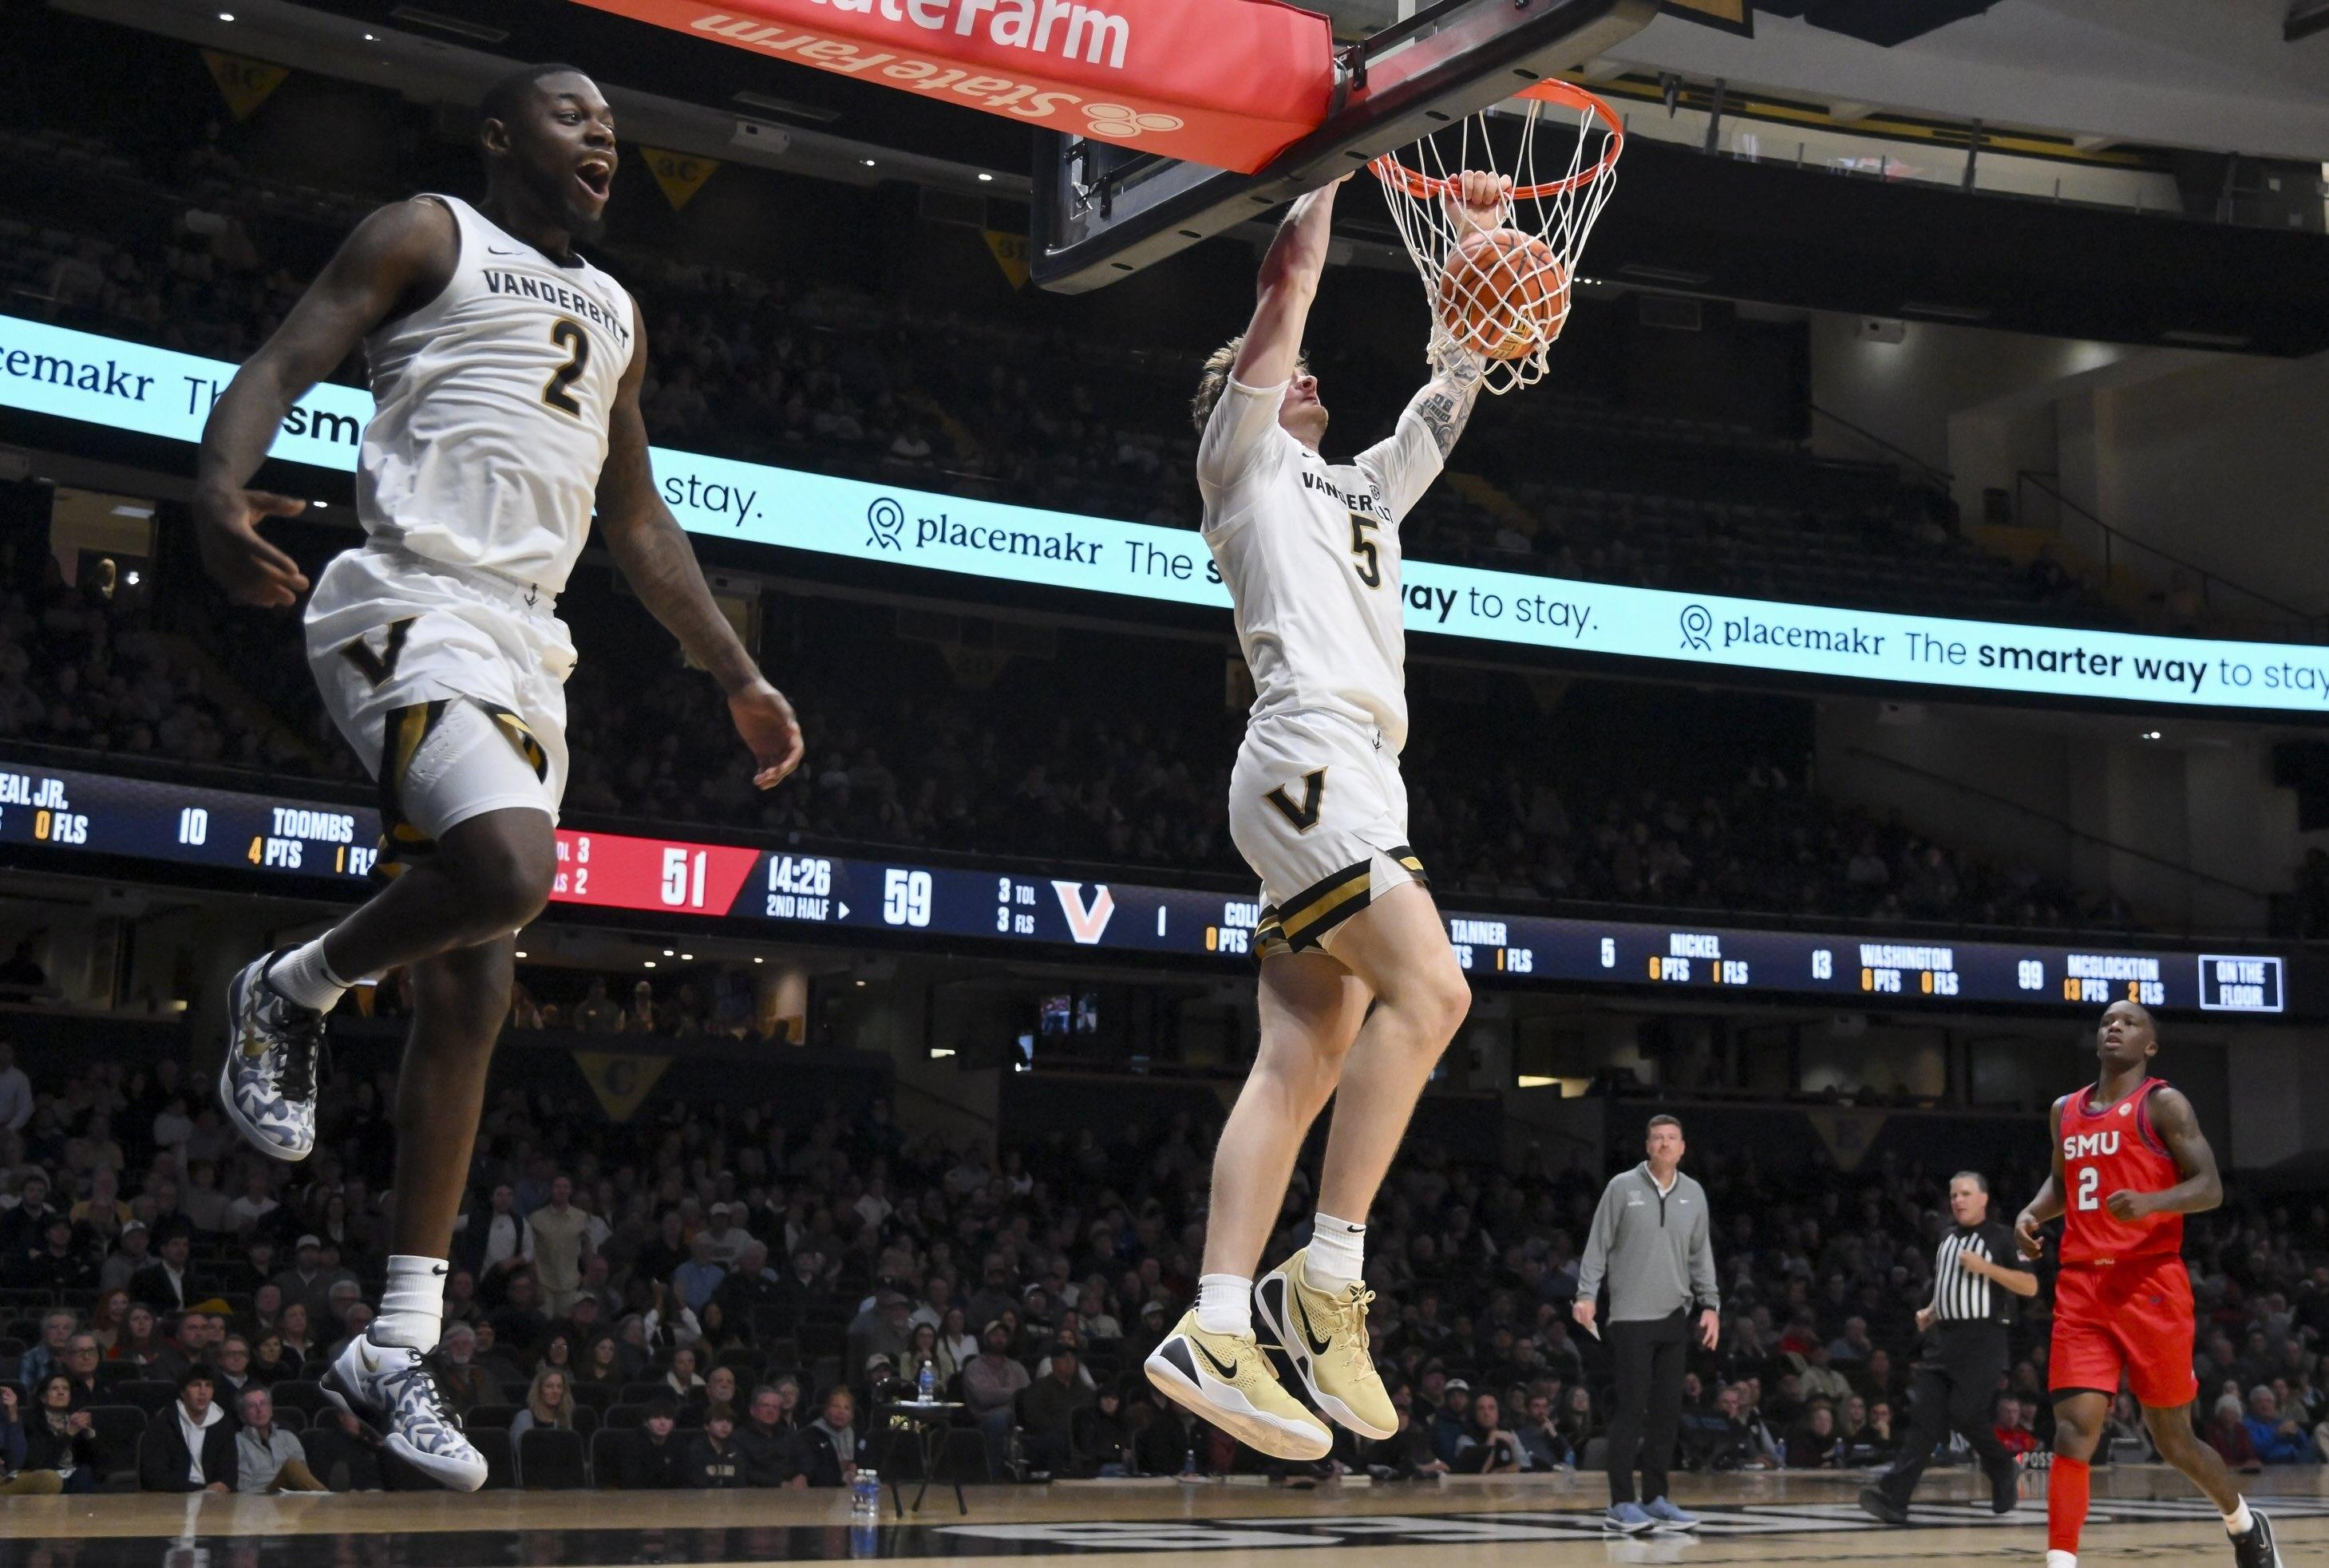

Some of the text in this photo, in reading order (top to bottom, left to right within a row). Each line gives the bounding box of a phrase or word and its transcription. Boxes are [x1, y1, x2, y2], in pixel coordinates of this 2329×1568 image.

[483, 269, 631, 350] VANDERBILT
[0, 345, 154, 401] emakr
[541, 317, 591, 421] 2
[664, 476, 763, 527] stay.
[1302, 472, 1394, 523] VANDERILT
[916, 514, 1103, 566] placemakr
[1125, 540, 1192, 581] The
[1347, 511, 1382, 590] 5
[1469, 587, 1503, 618] to
[1516, 594, 1598, 638] stay.
[1723, 616, 1885, 655] placemakr
[1905, 632, 1967, 665] The
[1979, 644, 2122, 677] smarter
[2133, 657, 2208, 693] way
[2220, 658, 2252, 686] to
[34, 777, 69, 810] JR.
[34, 810, 51, 840] 0
[53, 812, 89, 844] FLS
[178, 807, 208, 846] 10
[273, 807, 355, 843] TOOMBS
[248, 836, 262, 865] 4
[265, 837, 303, 869] PTS
[335, 845, 345, 874] 1
[576, 837, 590, 863] 3
[574, 867, 588, 895] 2
[661, 847, 707, 908] 51
[768, 855, 832, 896] 14:26
[884, 868, 932, 927] 59
[998, 877, 1036, 906] 3 TOL
[766, 894, 830, 921] 2ND HALF
[997, 906, 1035, 934] 3 FLS
[1157, 905, 1167, 937] 1
[1205, 926, 1248, 954] 0 PTS
[1450, 919, 1507, 946] TANNER
[1670, 933, 1721, 959] NICKEL
[1450, 944, 1532, 973] TS 1 FLS
[1601, 937, 1615, 968] 5
[1811, 949, 1833, 980] 13
[1859, 943, 1953, 972] WASHINGTON
[2067, 954, 2160, 981] MCGLOCKTON
[1662, 957, 1690, 982] PTS
[1712, 960, 1721, 983] 1
[1722, 959, 1749, 985] FLS
[1873, 968, 1902, 993] PTS
[1933, 970, 1959, 996] FLS
[2018, 959, 2044, 990] 99
[2216, 960, 2266, 985] ON THE
[2063, 978, 2165, 1005] 13 PTS 2 FLS
[2220, 984, 2264, 1007] FLOOR
[2063, 1130, 2120, 1160] SMU
[2078, 1166, 2099, 1211] 2
